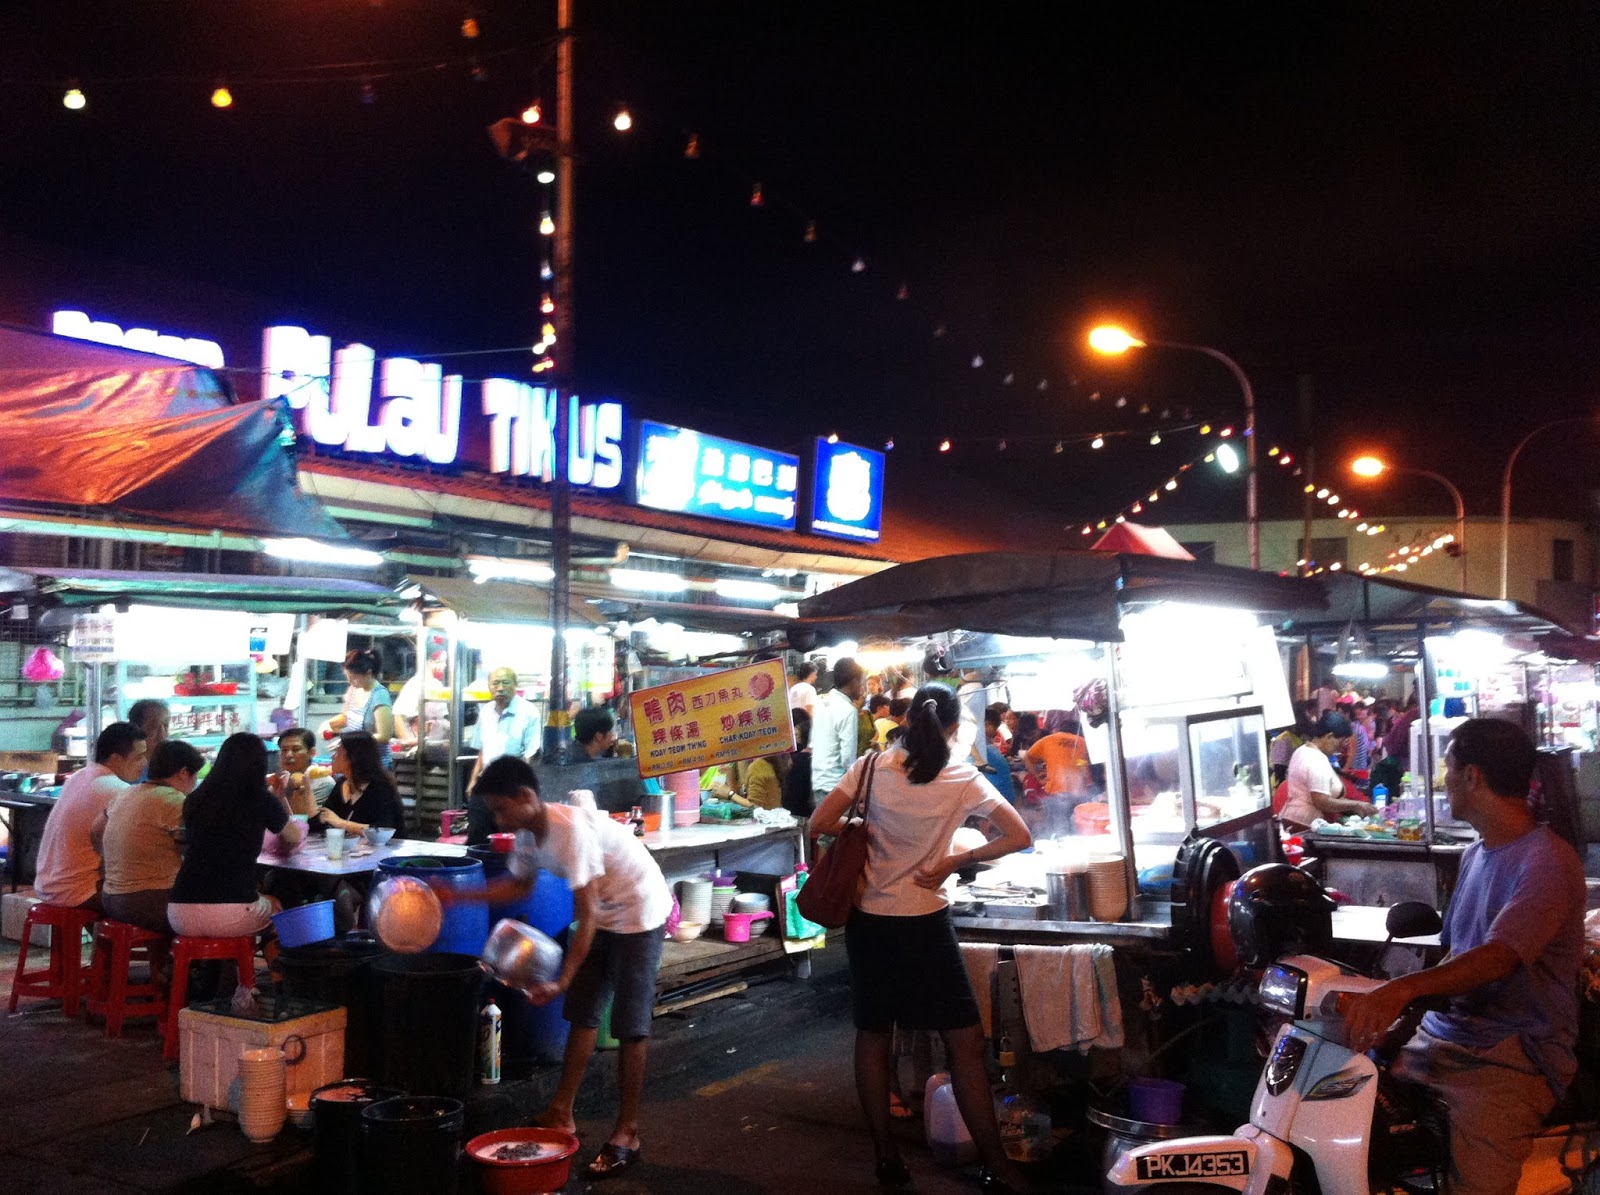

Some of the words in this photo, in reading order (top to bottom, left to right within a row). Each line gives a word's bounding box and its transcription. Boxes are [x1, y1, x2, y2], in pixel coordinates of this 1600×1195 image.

[482, 377, 623, 489] TIKUS
[643, 690, 687, 724] 鴨肉
[720, 735, 738, 744] CHAR
[739, 730, 756, 741] KOAY
[758, 726, 778, 737] TEOW
[650, 747, 667, 758] KOAY
[668, 744, 686, 755] TEOW
[1147, 1153, 1245, 1177] PKJ4353
